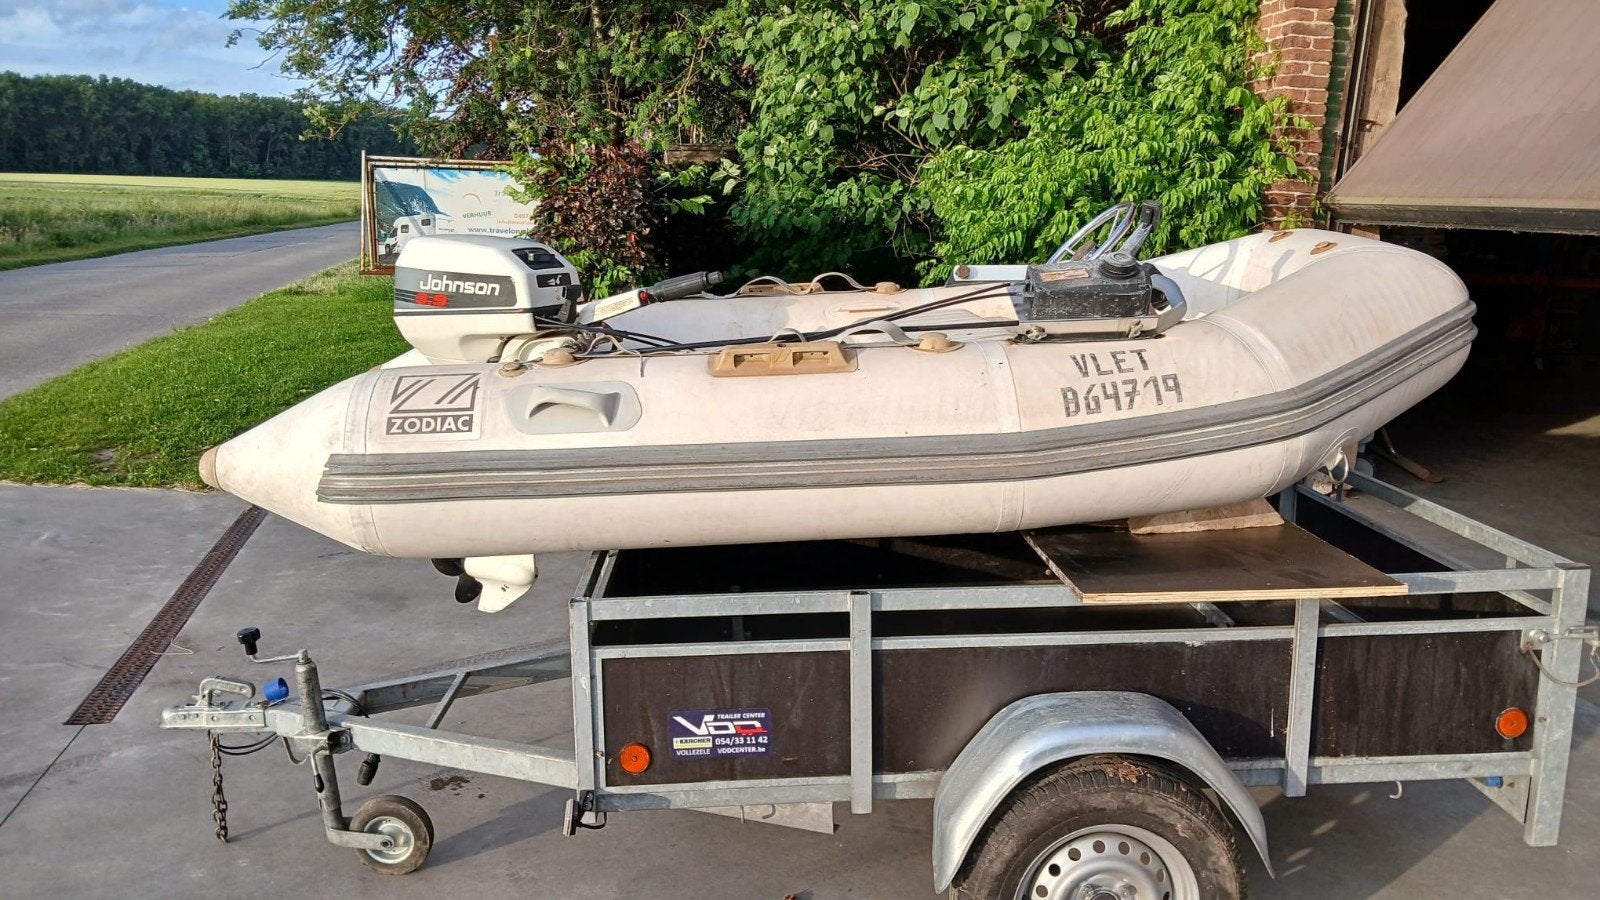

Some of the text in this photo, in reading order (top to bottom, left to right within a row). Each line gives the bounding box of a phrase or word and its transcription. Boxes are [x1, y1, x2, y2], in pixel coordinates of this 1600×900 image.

[462, 210, 492, 219] VERHUUR
[419, 273, 500, 296] Johnson
[1069, 348, 1149, 378] VLET
[388, 416, 470, 433] ZODIAC
[715, 737, 744, 746] 054/33
[717, 746, 766, 754] VDDCENTER.be
